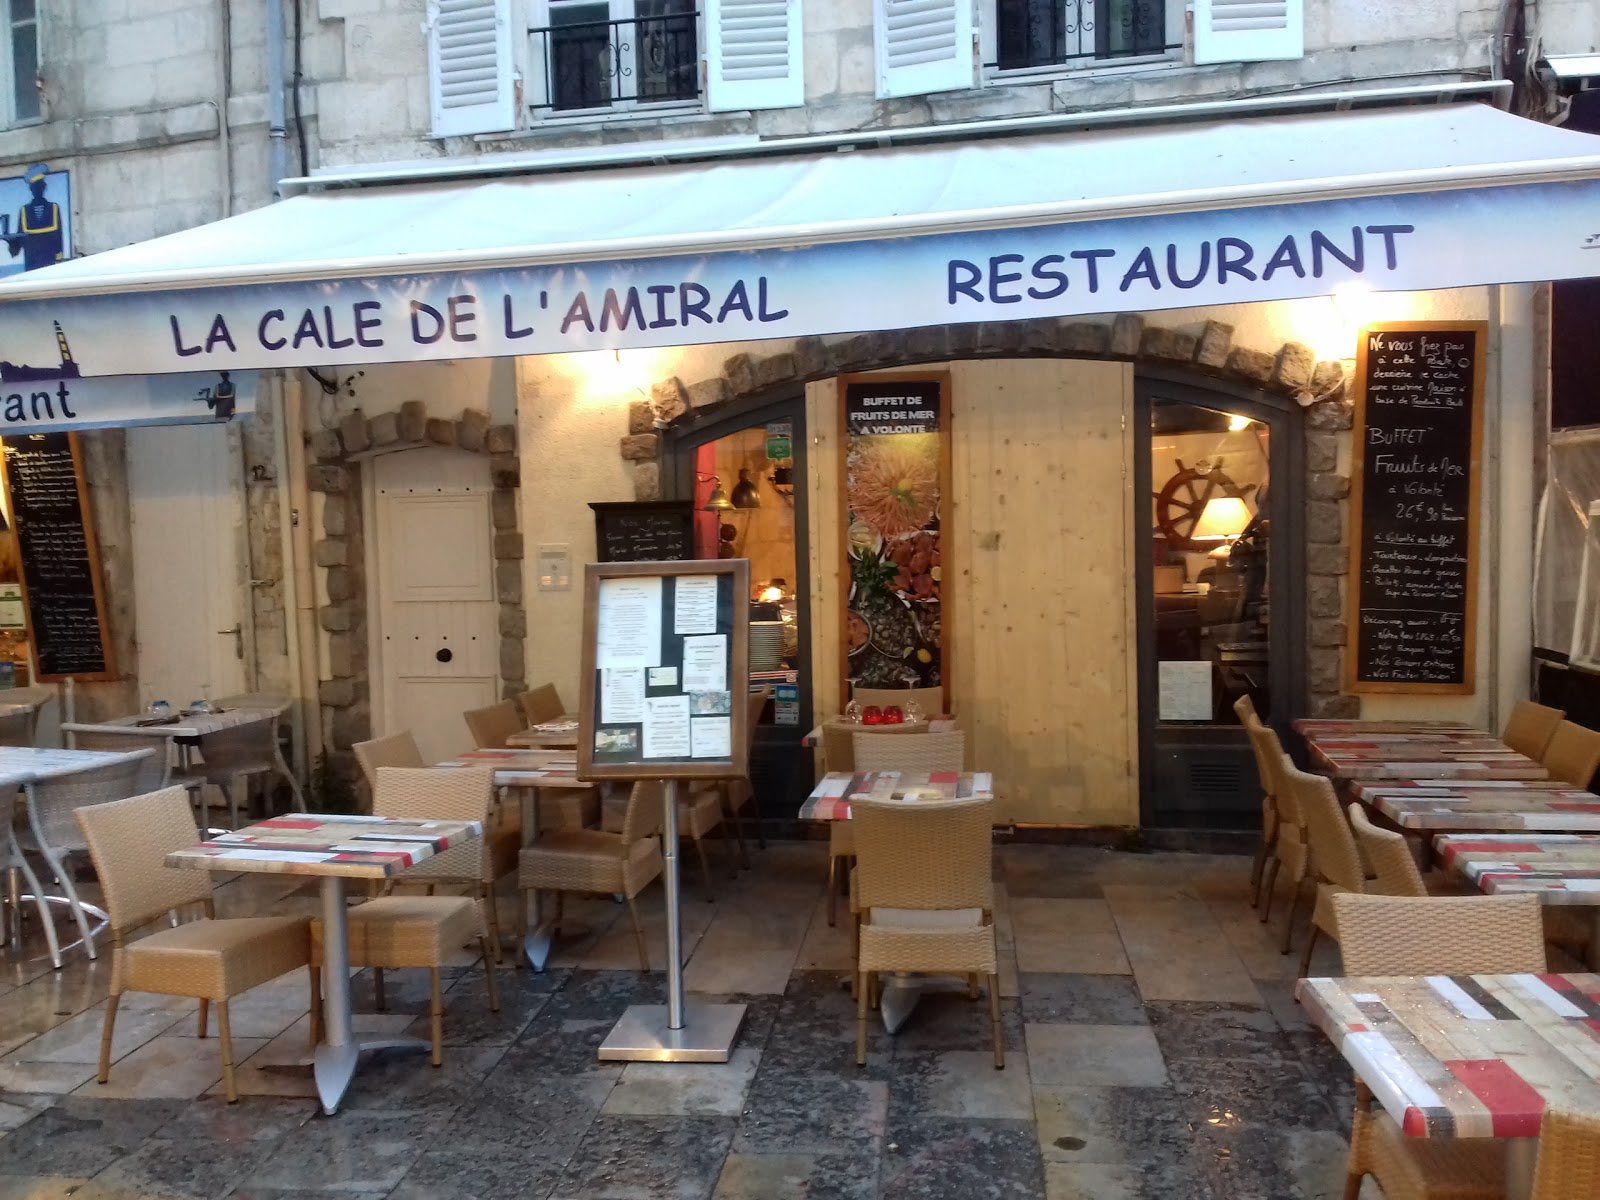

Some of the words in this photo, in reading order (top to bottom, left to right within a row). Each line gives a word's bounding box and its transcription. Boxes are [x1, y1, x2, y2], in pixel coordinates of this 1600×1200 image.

[947, 224, 1415, 305] RESTAURANT
[170, 313, 237, 356] LA
[258, 301, 383, 351] CALE
[410, 295, 477, 345] DE
[503, 276, 789, 341] L'AMIRAL
[1369, 332, 1385, 352] Ne
[1388, 340, 1415, 351] vous
[0, 381, 77, 422] ant
[862, 396, 905, 406] BUFFET
[906, 396, 923, 405] DE
[850, 411, 890, 420] FRUITS
[891, 411, 907, 420] DE
[908, 410, 935, 419] MER
[860, 426, 870, 435] A
[872, 425, 926, 434] VOLONTE
